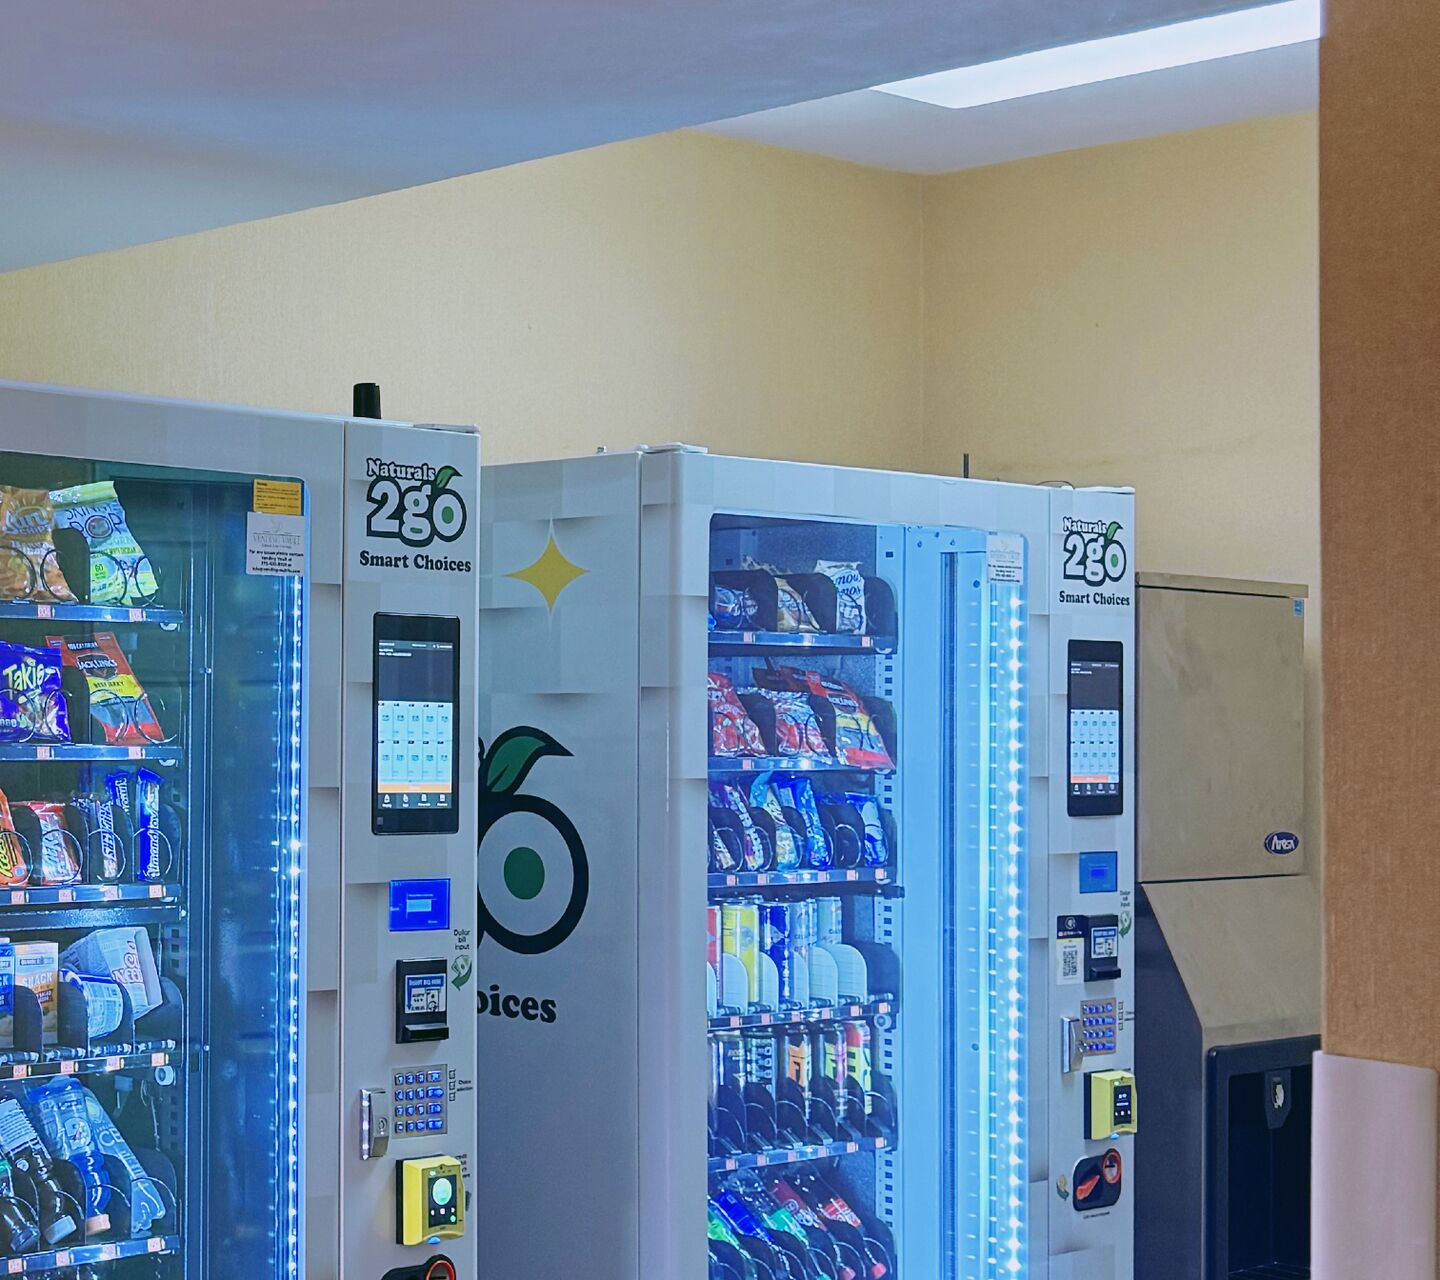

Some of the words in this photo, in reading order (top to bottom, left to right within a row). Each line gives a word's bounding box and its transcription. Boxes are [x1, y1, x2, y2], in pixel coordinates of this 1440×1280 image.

[366, 457, 436, 481] Naturals
[366, 475, 468, 548] 2go
[1063, 517, 1107, 534] Naturals
[359, 549, 409, 568] Smart
[413, 553, 472, 572] Choices
[1063, 531, 1127, 587] 2go
[1059, 590, 1090, 604] Smart
[1093, 591, 1130, 606] Choices
[147, 830, 161, 878] Almond
